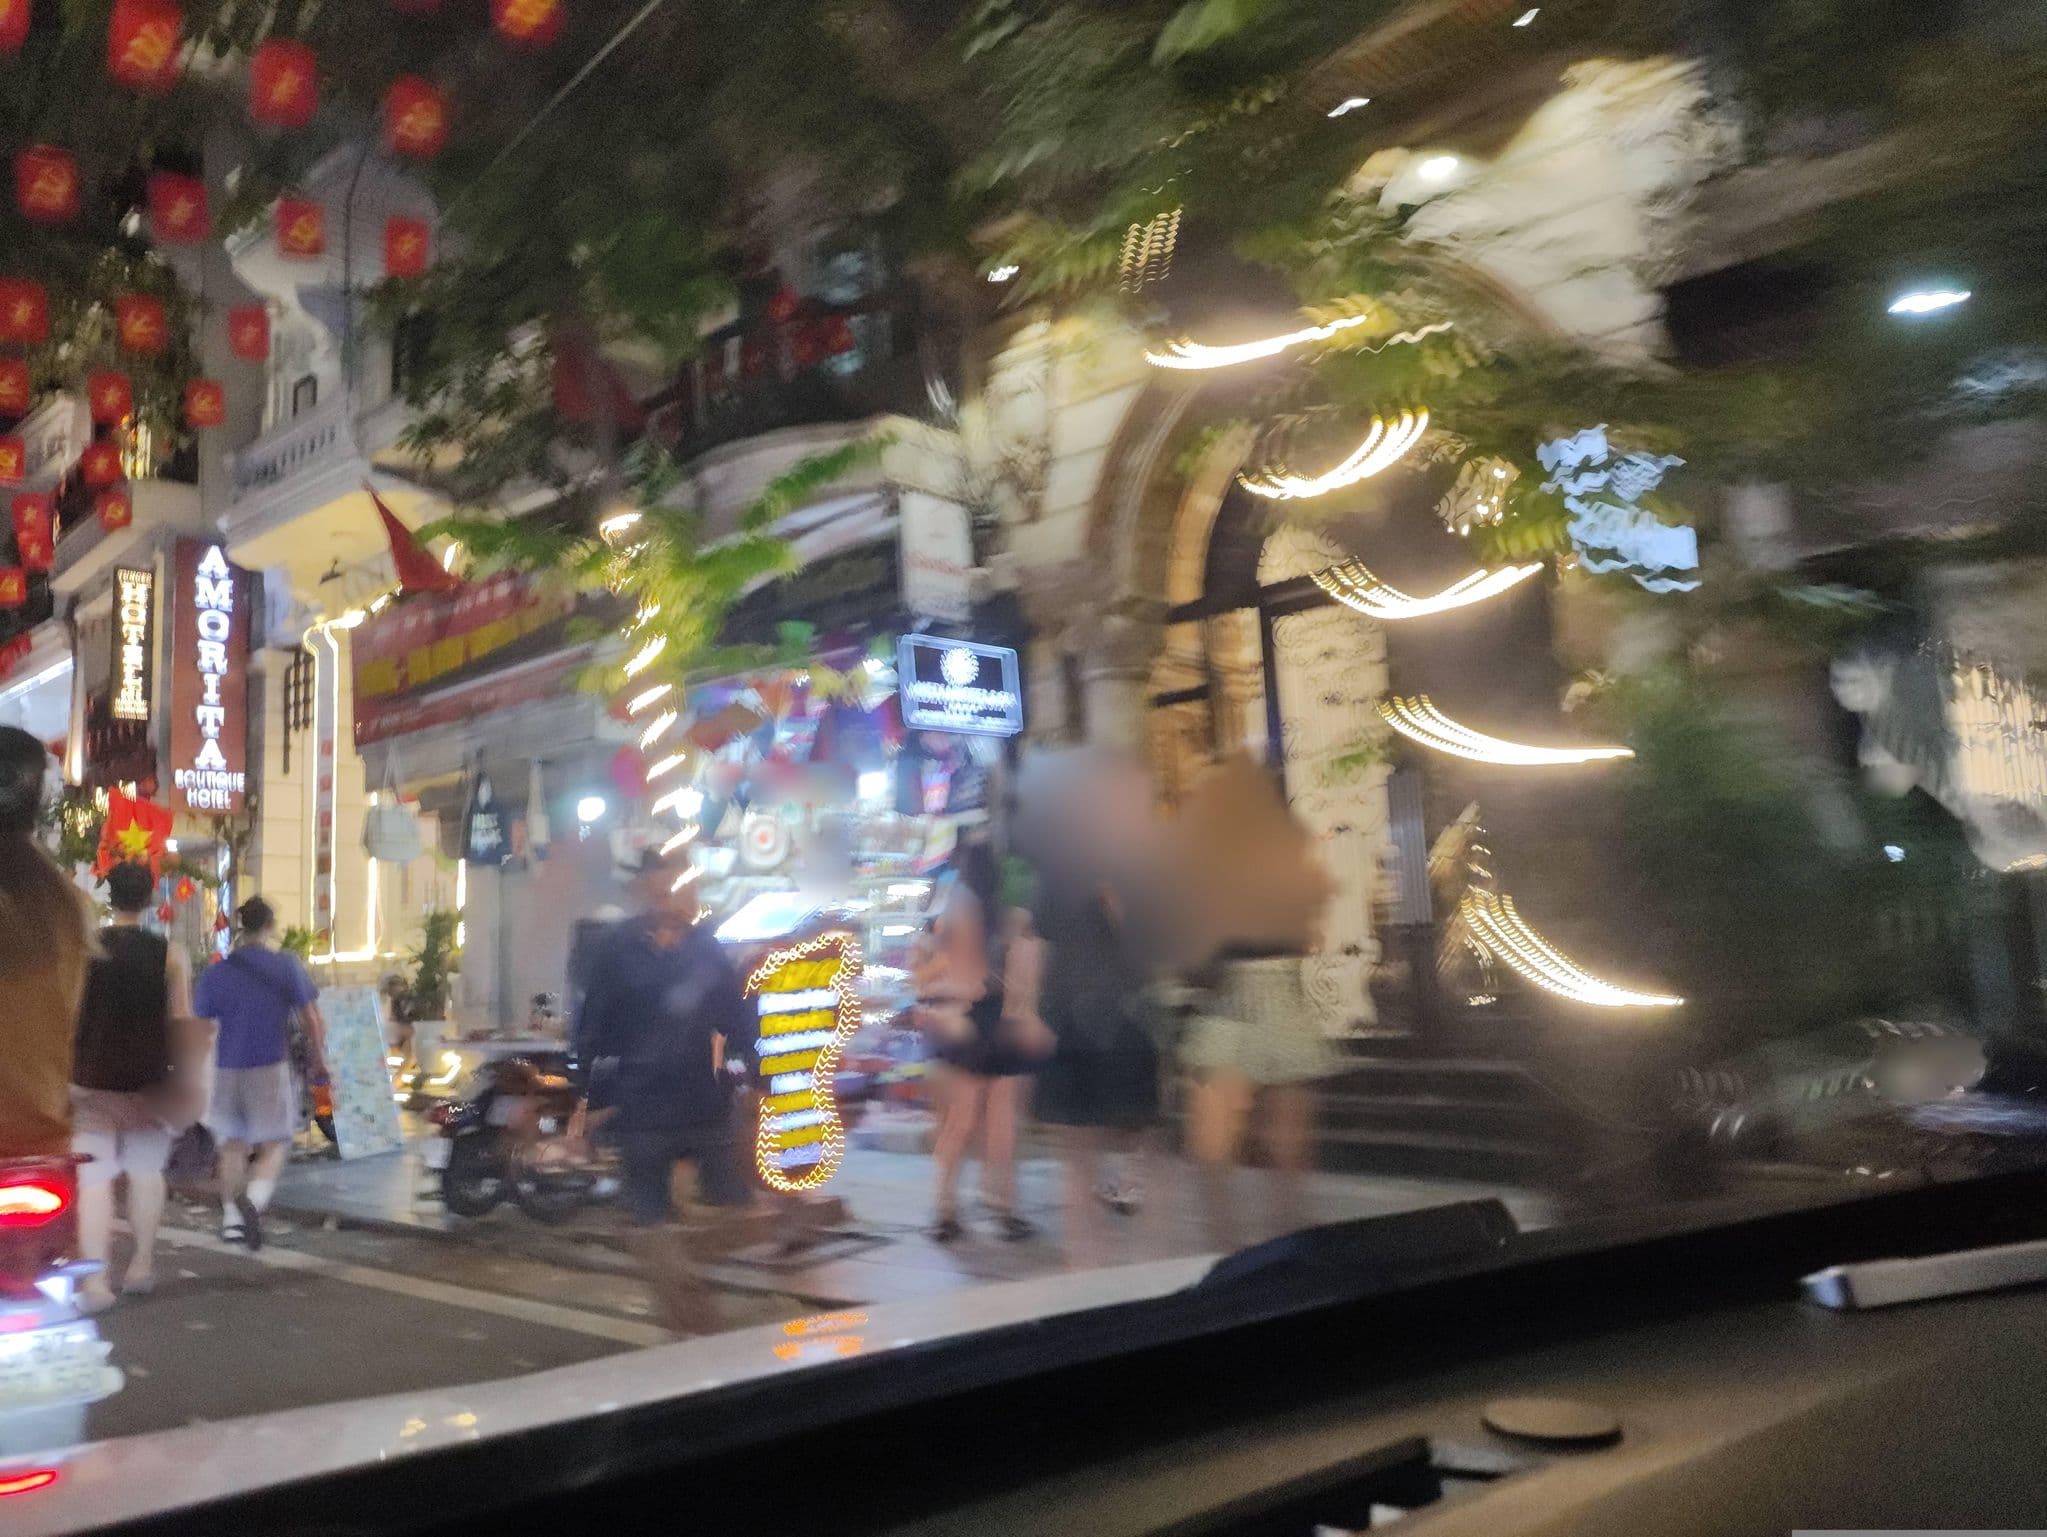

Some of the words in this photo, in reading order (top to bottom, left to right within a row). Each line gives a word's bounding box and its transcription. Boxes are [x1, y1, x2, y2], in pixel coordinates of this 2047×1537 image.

[195, 545, 233, 769] AMORITA
[175, 768, 245, 792] BOUTIQUE
[187, 788, 231, 809] HOTEL
